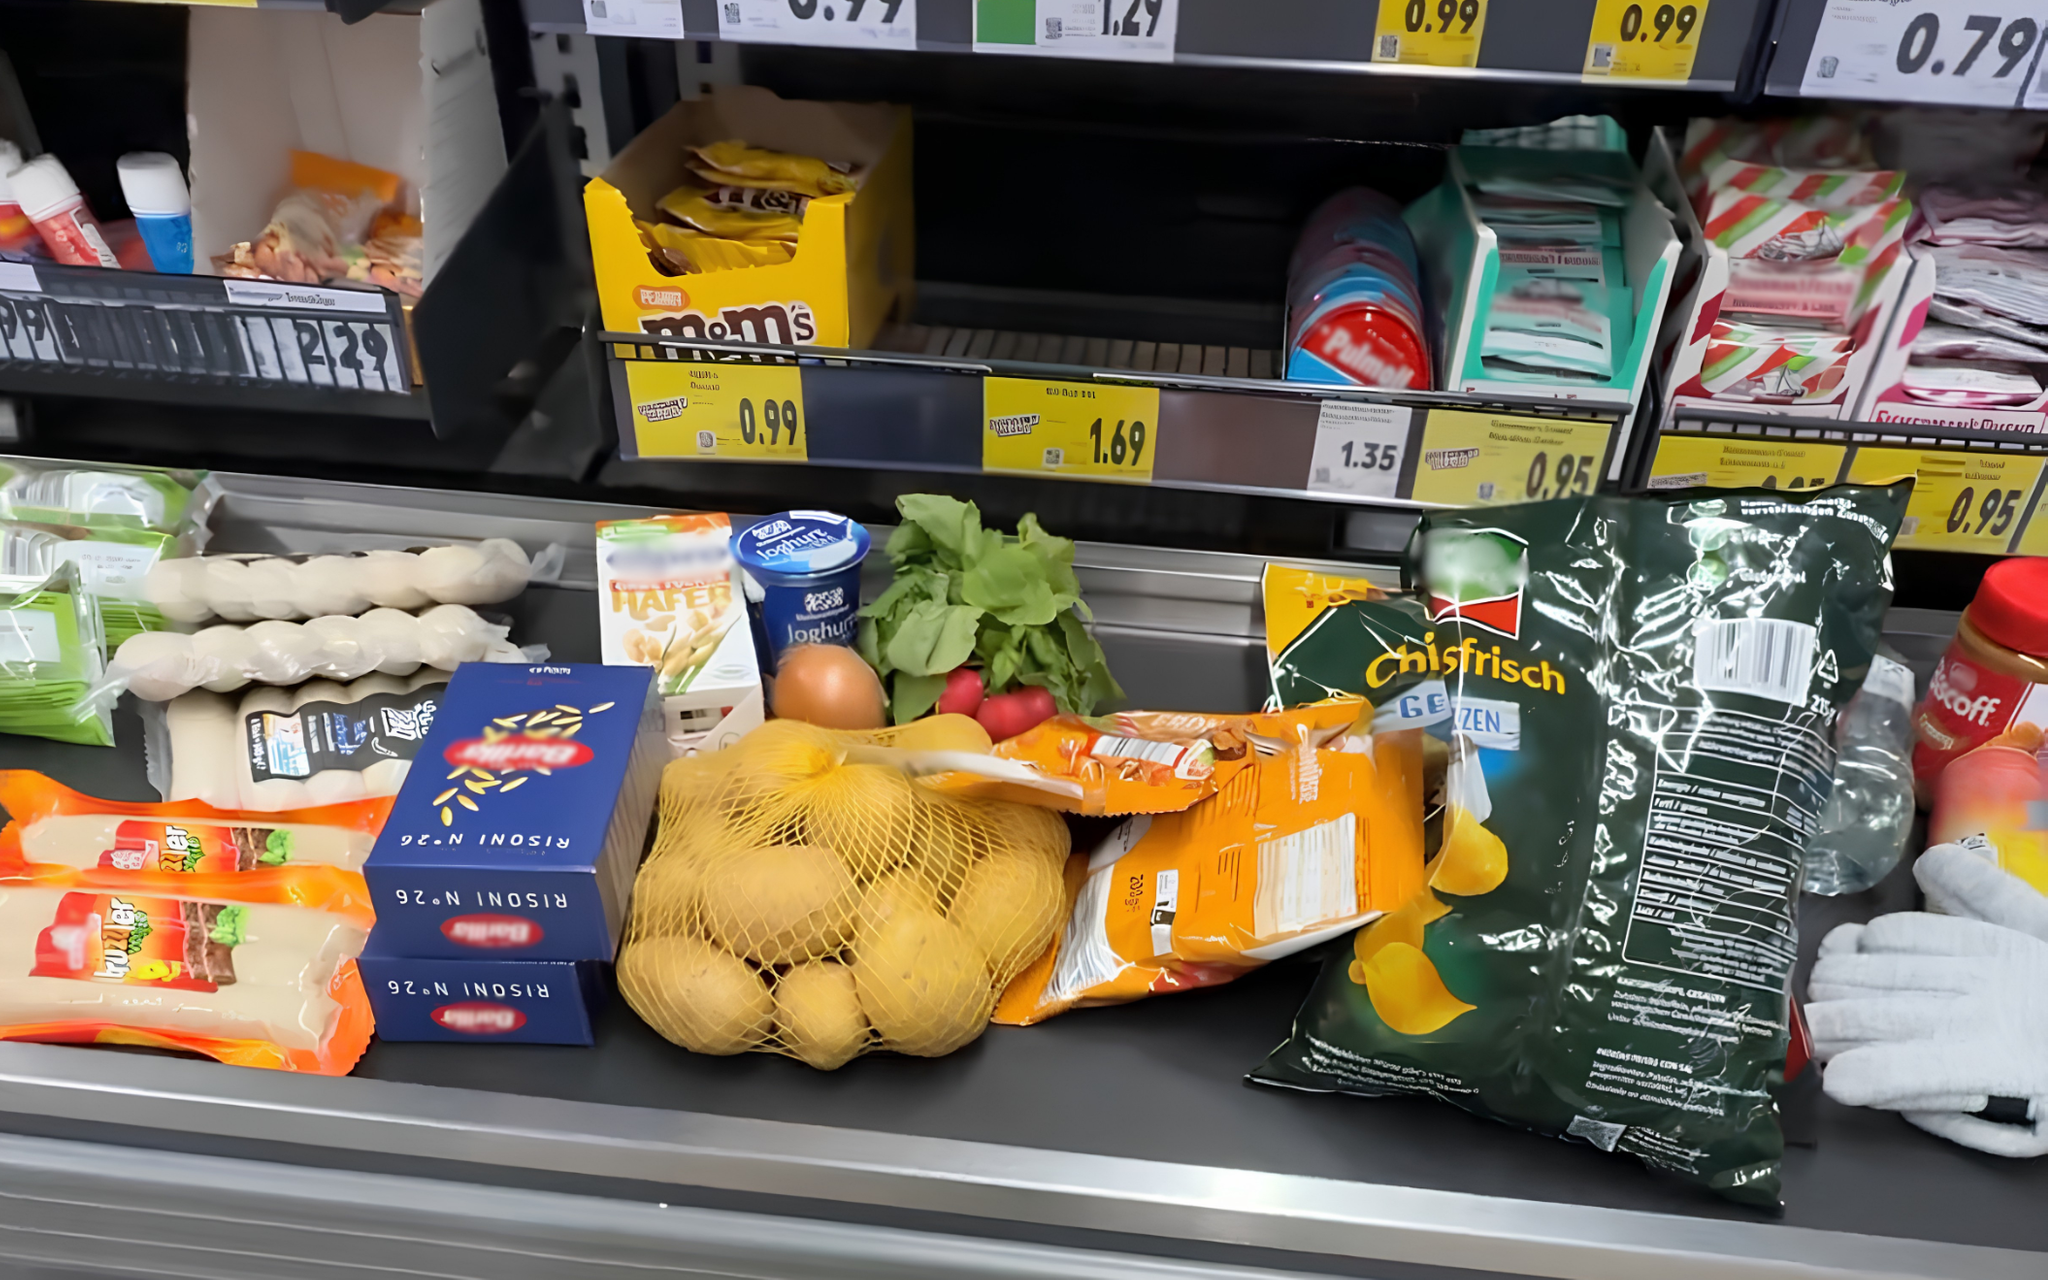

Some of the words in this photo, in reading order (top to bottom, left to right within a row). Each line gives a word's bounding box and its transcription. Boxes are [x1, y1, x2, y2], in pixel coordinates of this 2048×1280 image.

[1405, 0, 1479, 34] 0.99
[1620, 4, 1698, 44] 0.99
[1897, 12, 2038, 78] 0.79
[740, 398, 798, 446] 0.99
[1090, 417, 1146, 466] 1.69
[1341, 440, 1398, 471] 1.35
[1526, 451, 1595, 498] 0.95
[1947, 487, 2023, 536] 0.95
[479, 833, 570, 850] RISONI
[477, 891, 568, 909] RISONI
[464, 981, 550, 998] RISONI
